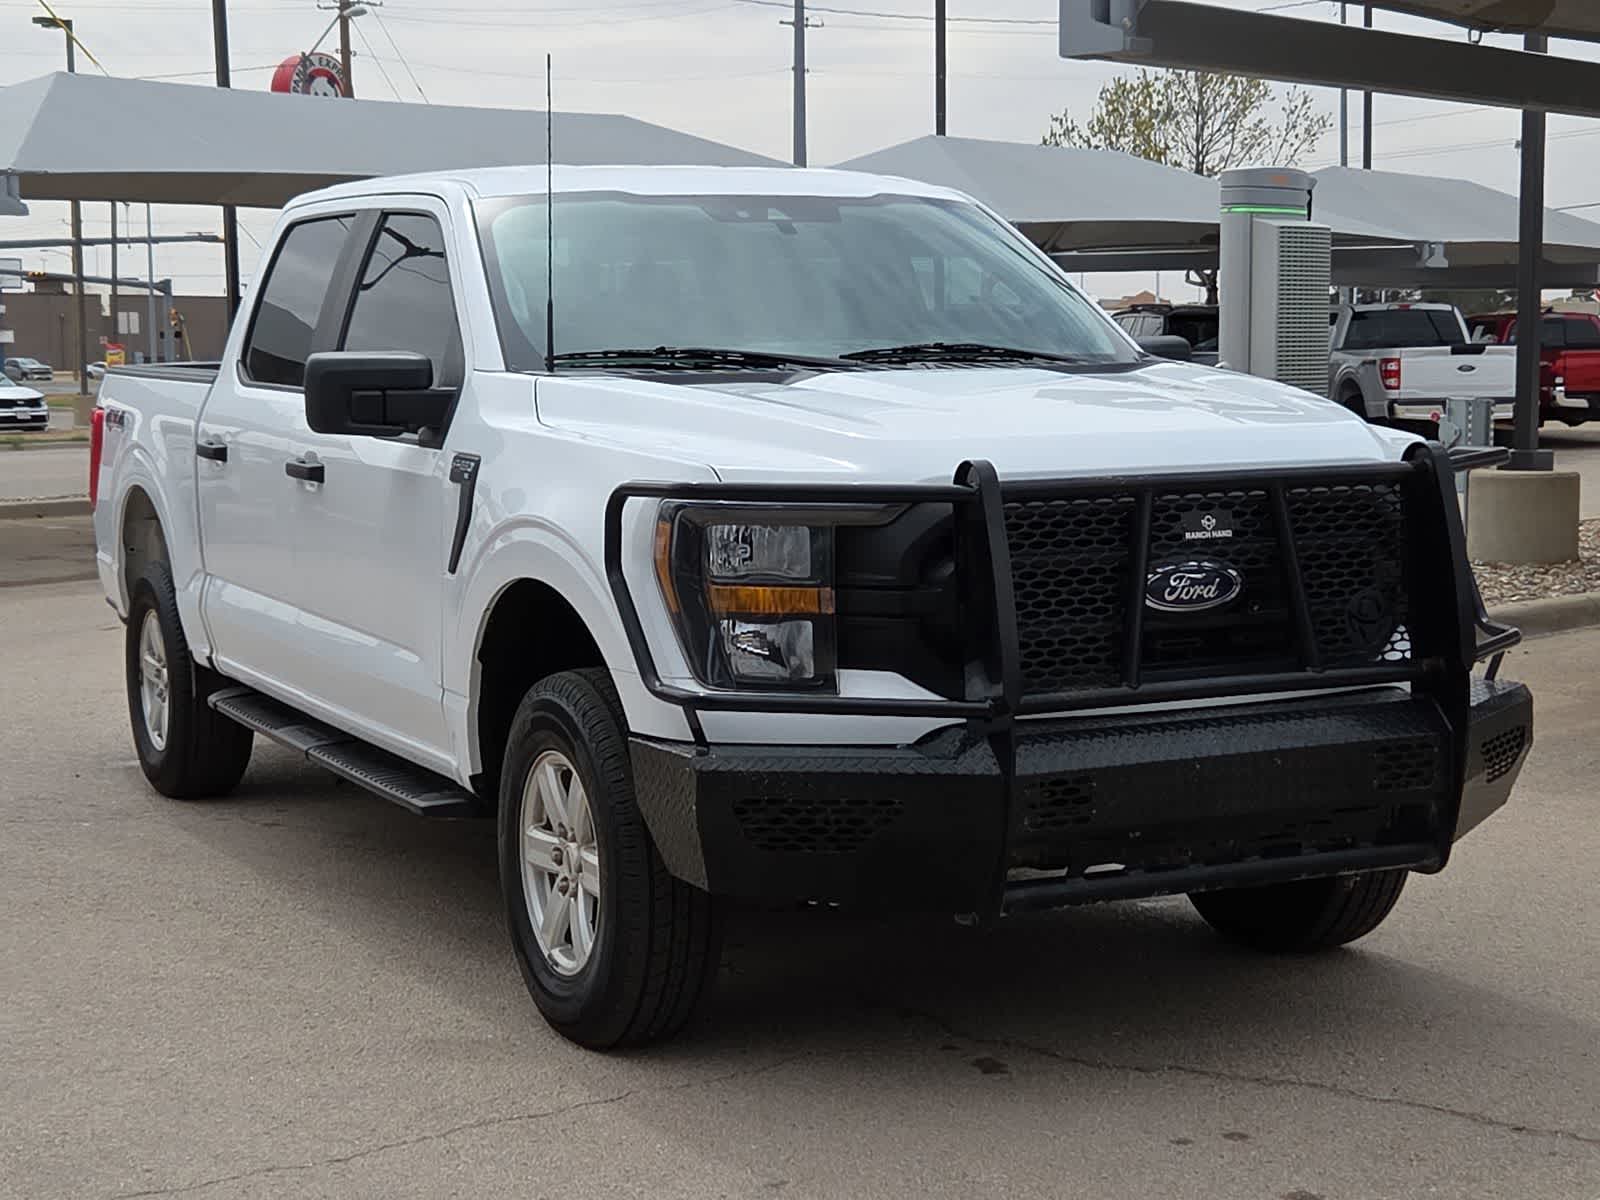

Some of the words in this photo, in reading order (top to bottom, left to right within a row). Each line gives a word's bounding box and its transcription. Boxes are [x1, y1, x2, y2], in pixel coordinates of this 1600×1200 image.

[1185, 530, 1211, 539] RANCH
[1212, 529, 1233, 538] HAND
[1164, 572, 1220, 601] Ford
